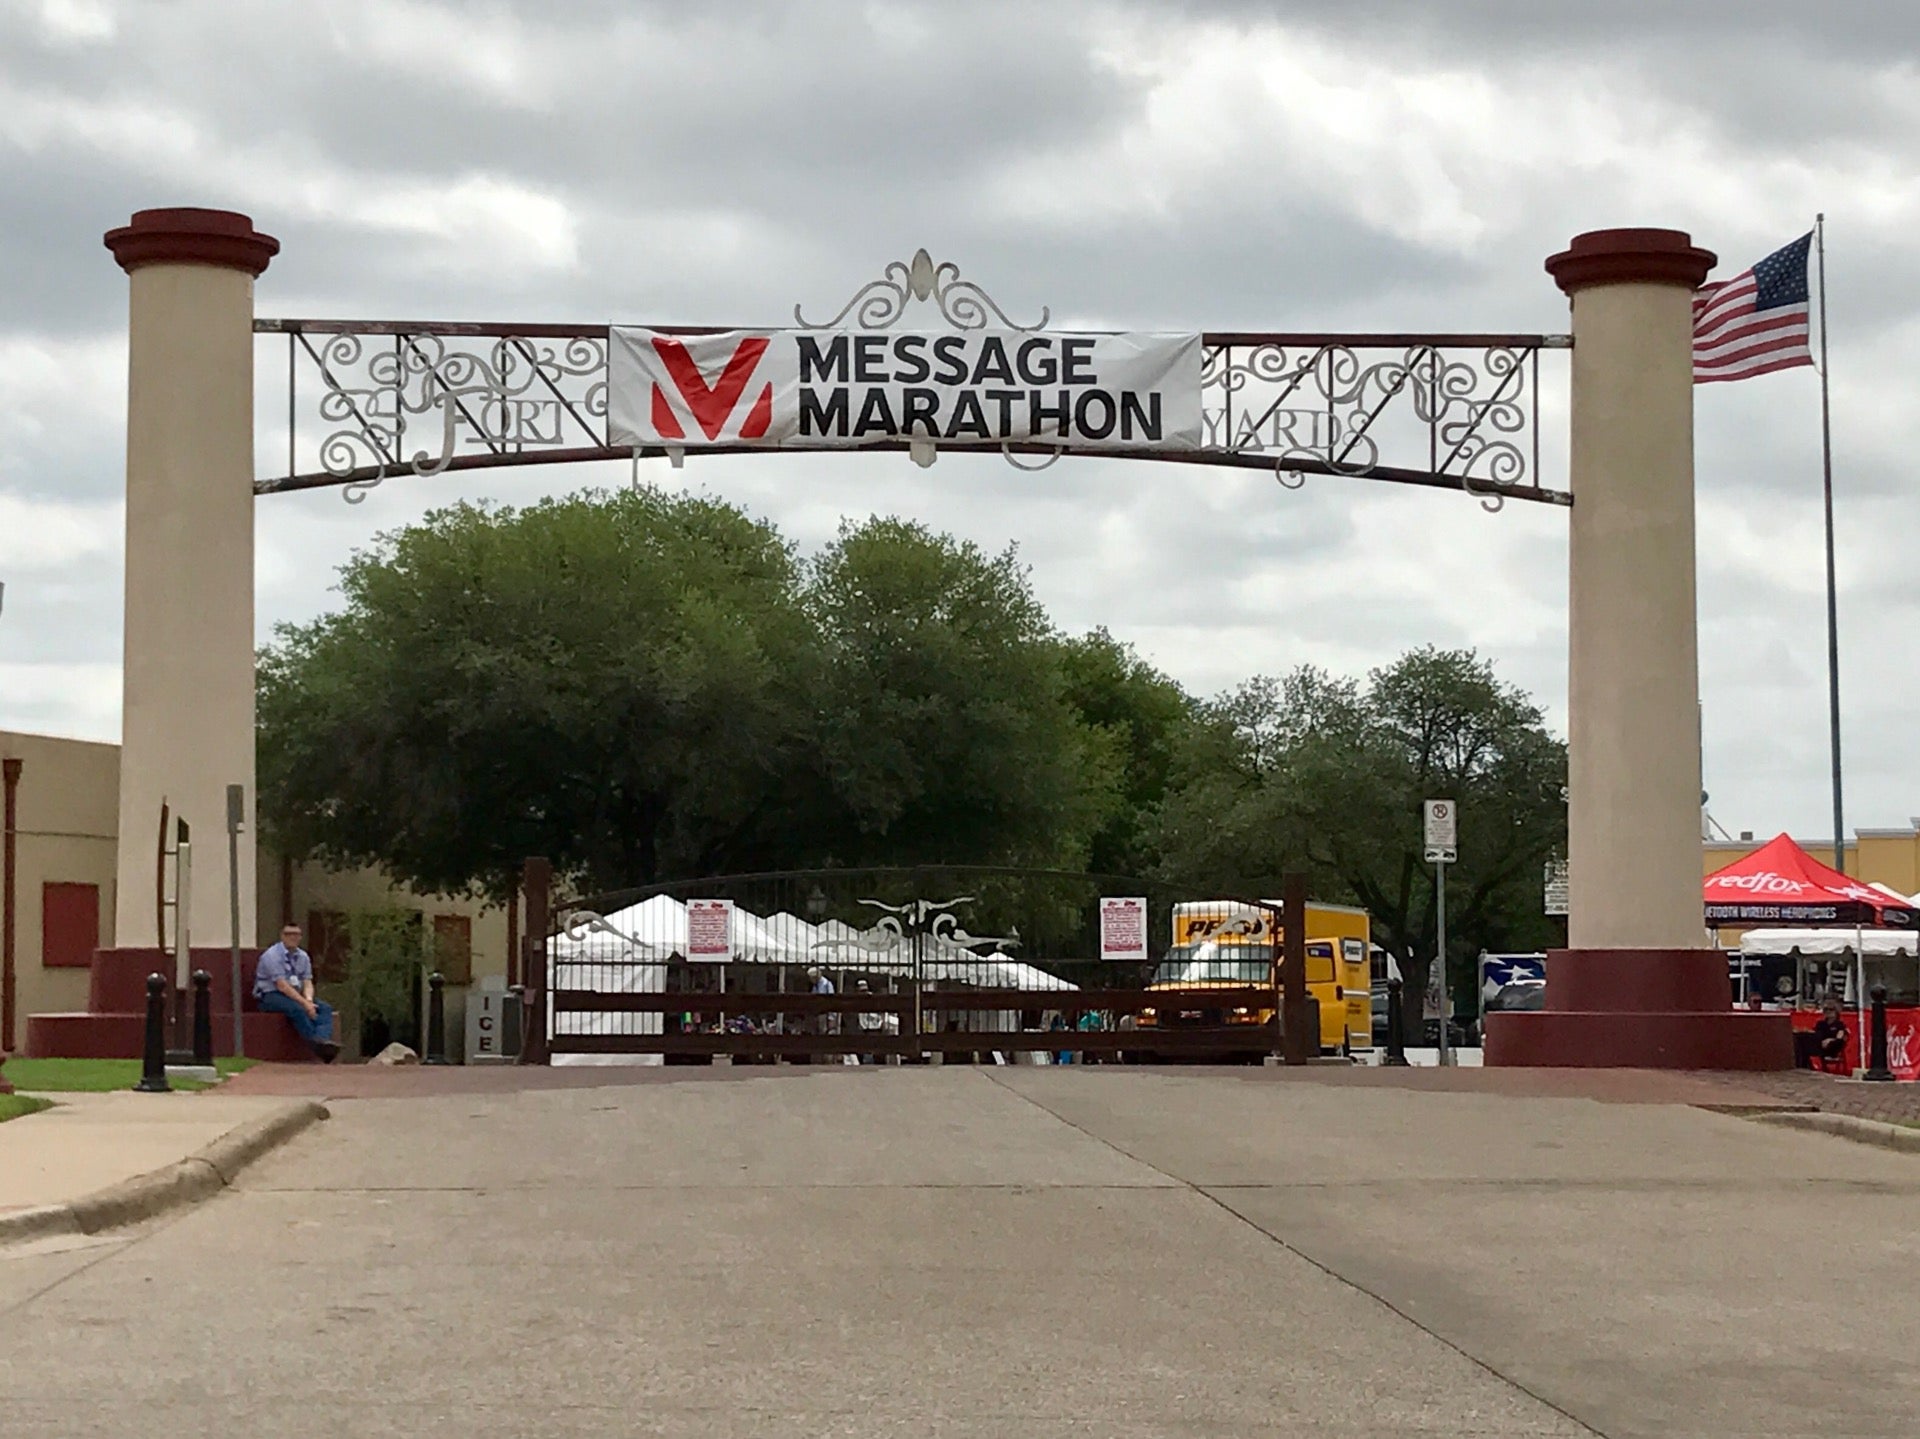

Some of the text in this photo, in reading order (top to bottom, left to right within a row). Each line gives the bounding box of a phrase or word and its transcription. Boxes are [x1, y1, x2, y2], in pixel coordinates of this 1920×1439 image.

[797, 335, 1097, 385] MESSAGE
[411, 386, 563, 477] FORT
[800, 387, 1162, 441] MARATHON
[1704, 872, 1803, 893] redfox
[1741, 906, 1780, 918] WIRELESS
[479, 996, 493, 1052] ICE
